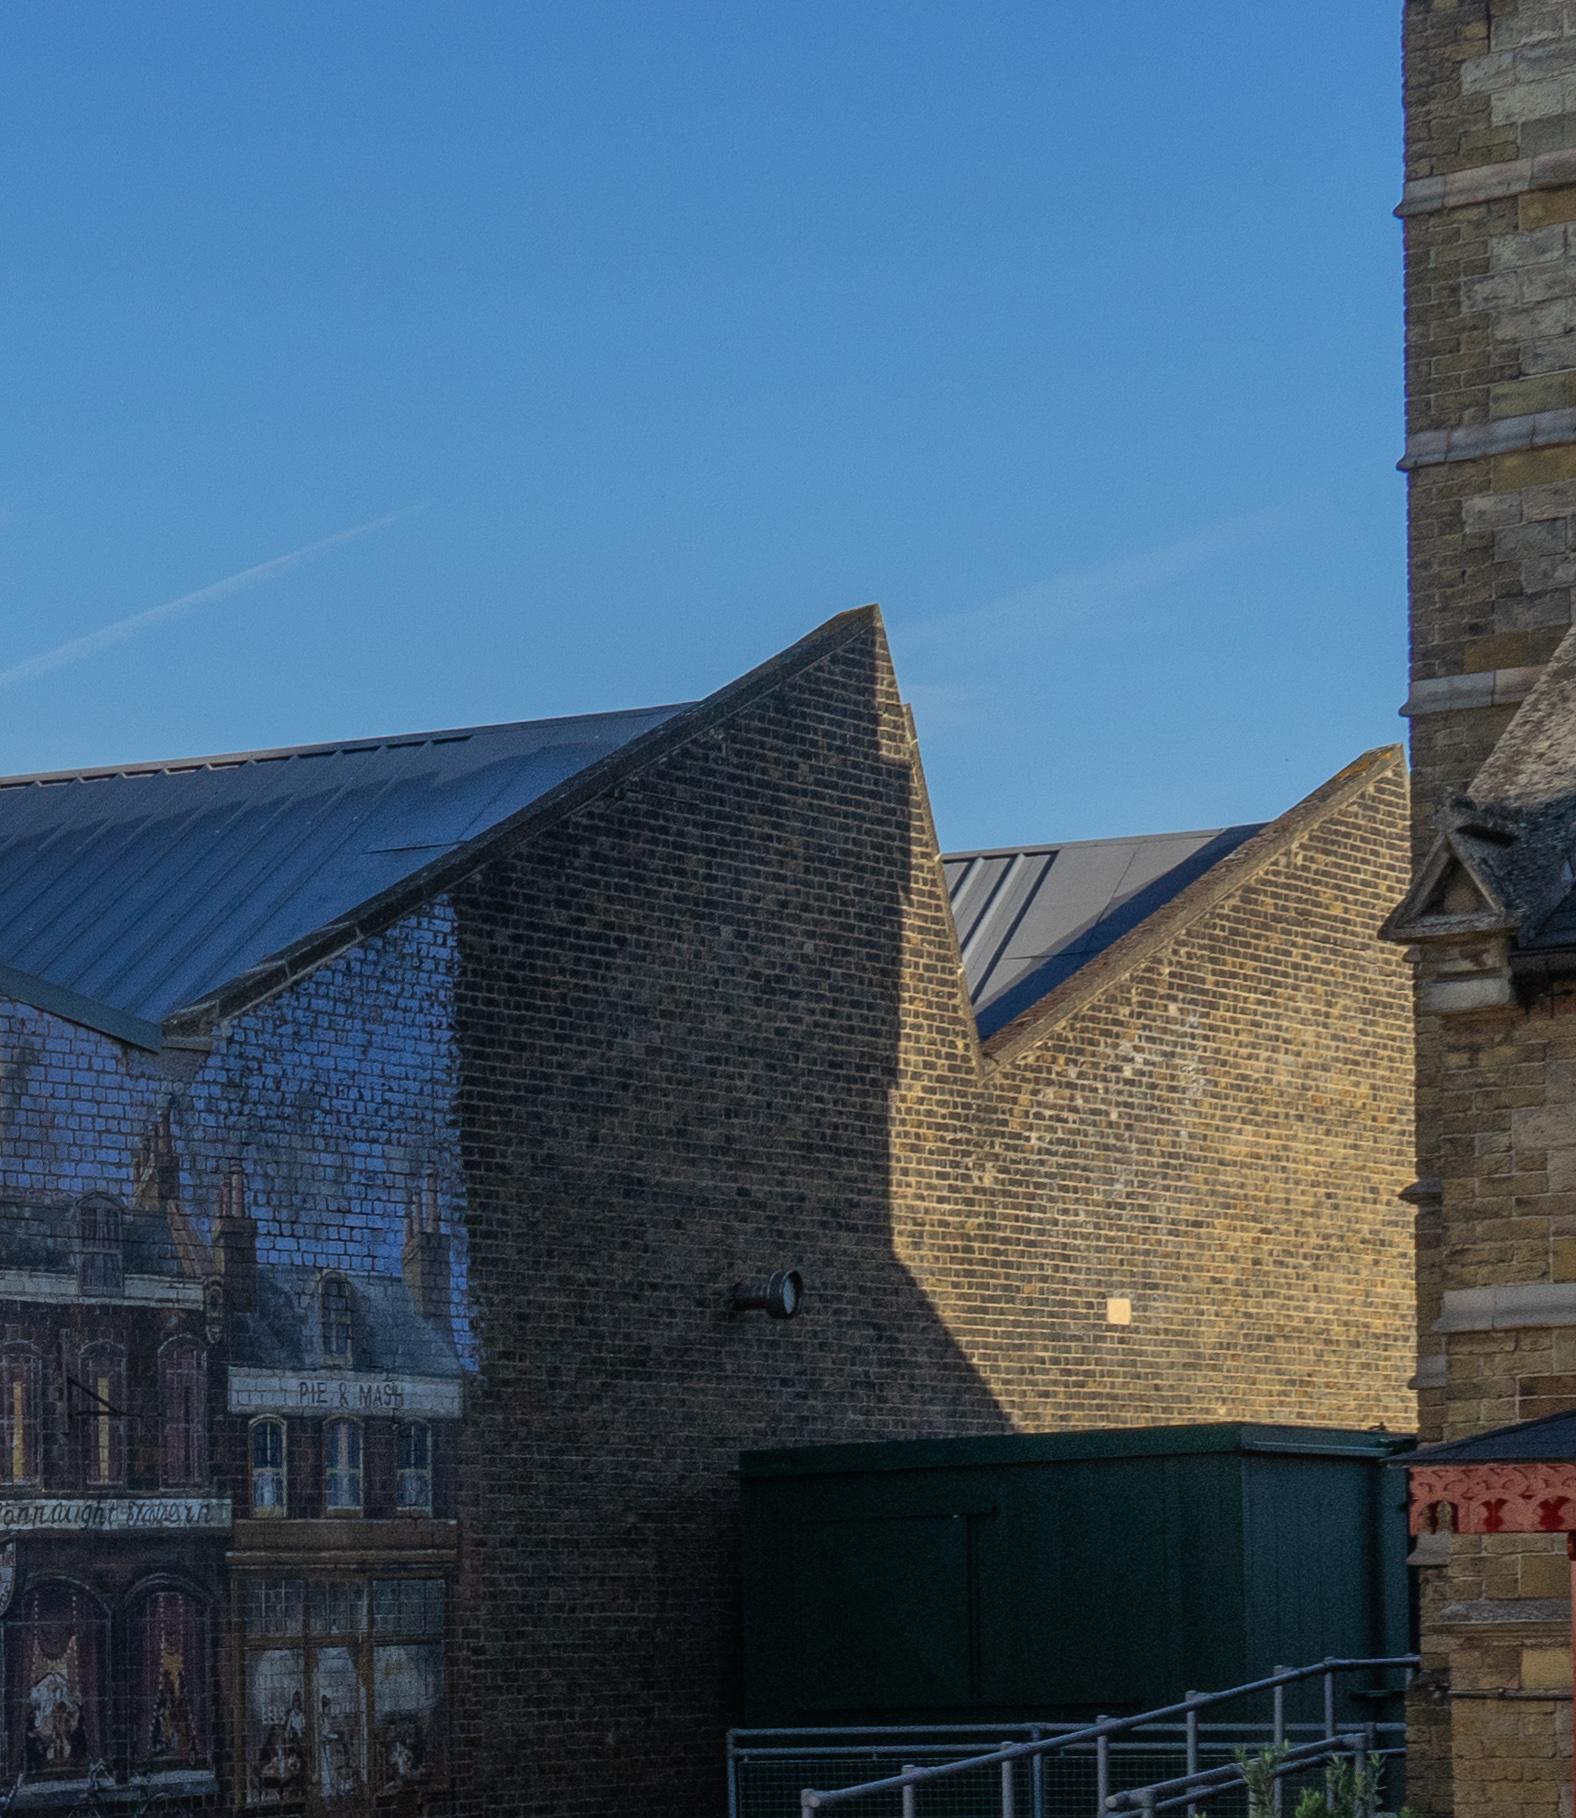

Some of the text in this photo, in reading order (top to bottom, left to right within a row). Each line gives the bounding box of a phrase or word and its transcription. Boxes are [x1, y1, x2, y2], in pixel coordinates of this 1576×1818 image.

[299, 1381, 403, 1407] PIE & MASH
[128, 1500, 211, 1526] Tavern
